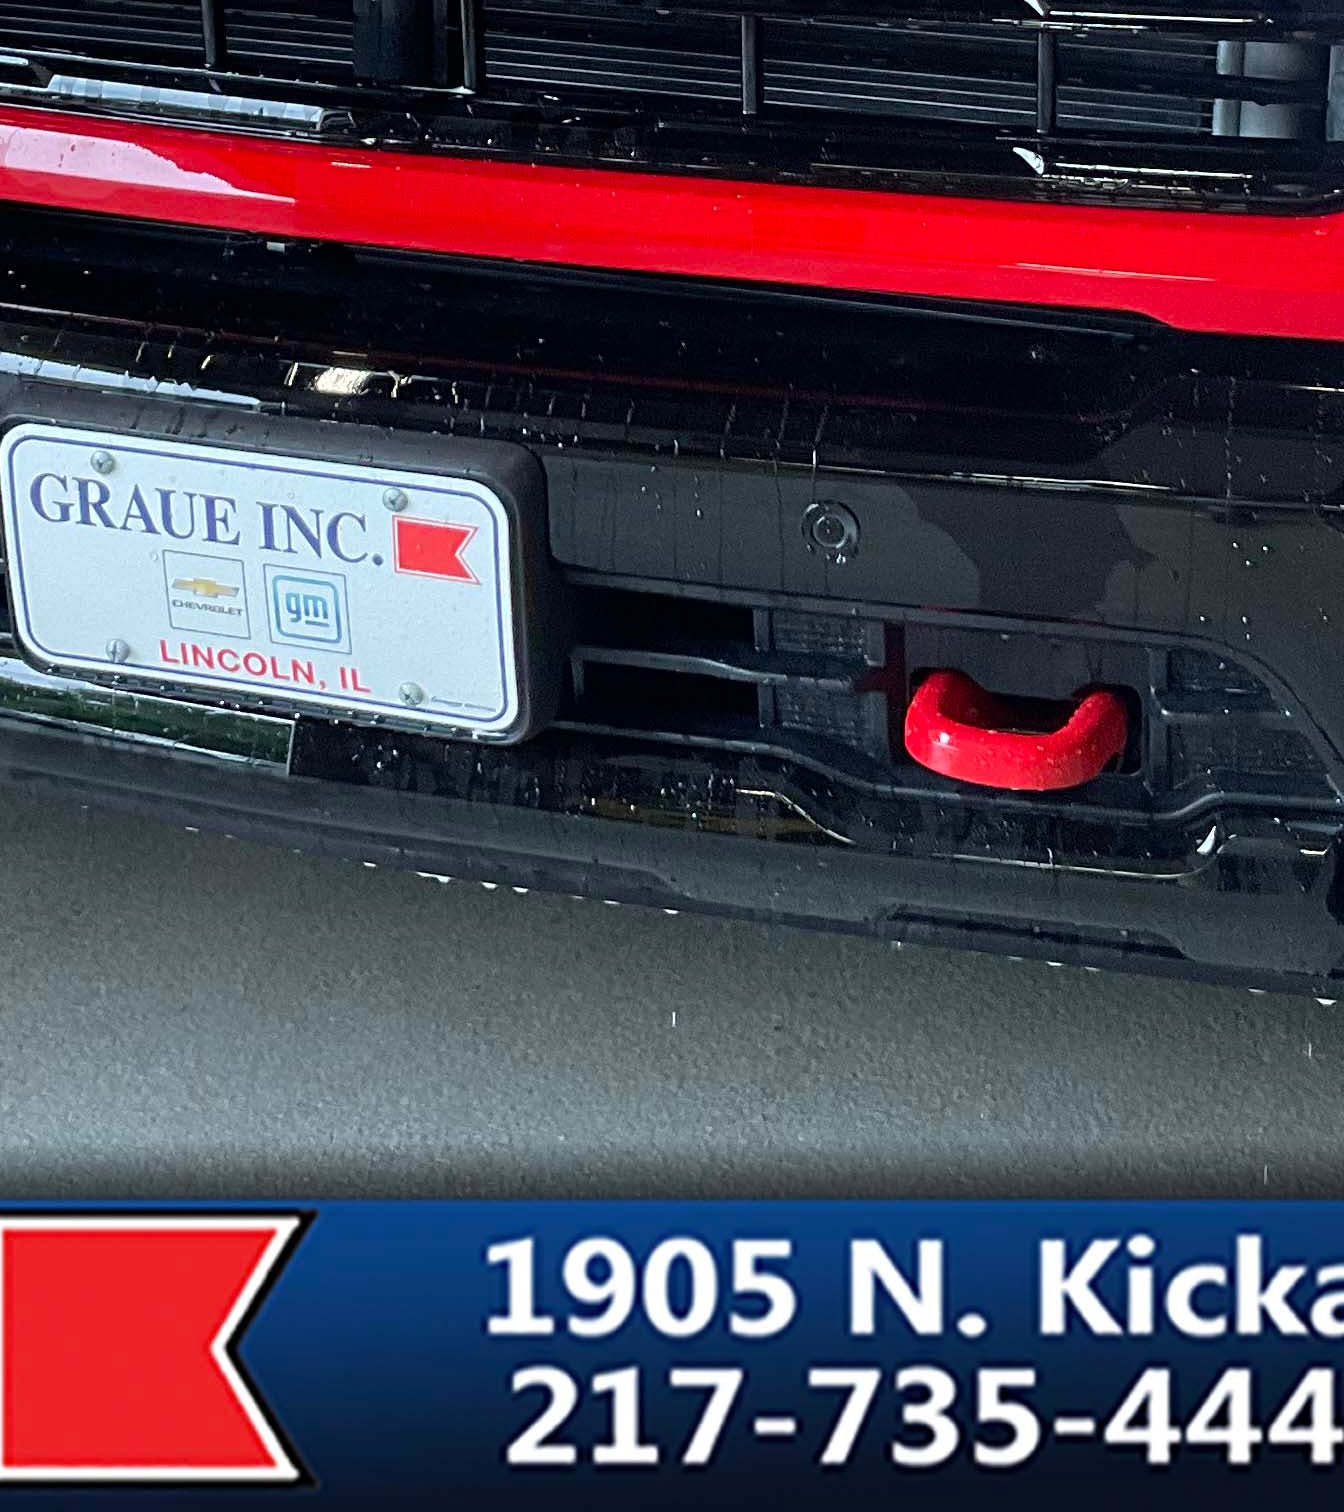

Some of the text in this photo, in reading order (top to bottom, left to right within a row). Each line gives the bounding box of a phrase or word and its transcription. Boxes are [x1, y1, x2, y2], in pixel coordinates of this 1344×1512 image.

[29, 472, 385, 567] GRAUE INC.
[171, 598, 244, 618] CHEVROLET
[285, 590, 329, 623] gm
[159, 639, 371, 693] LINCOLN, IL
